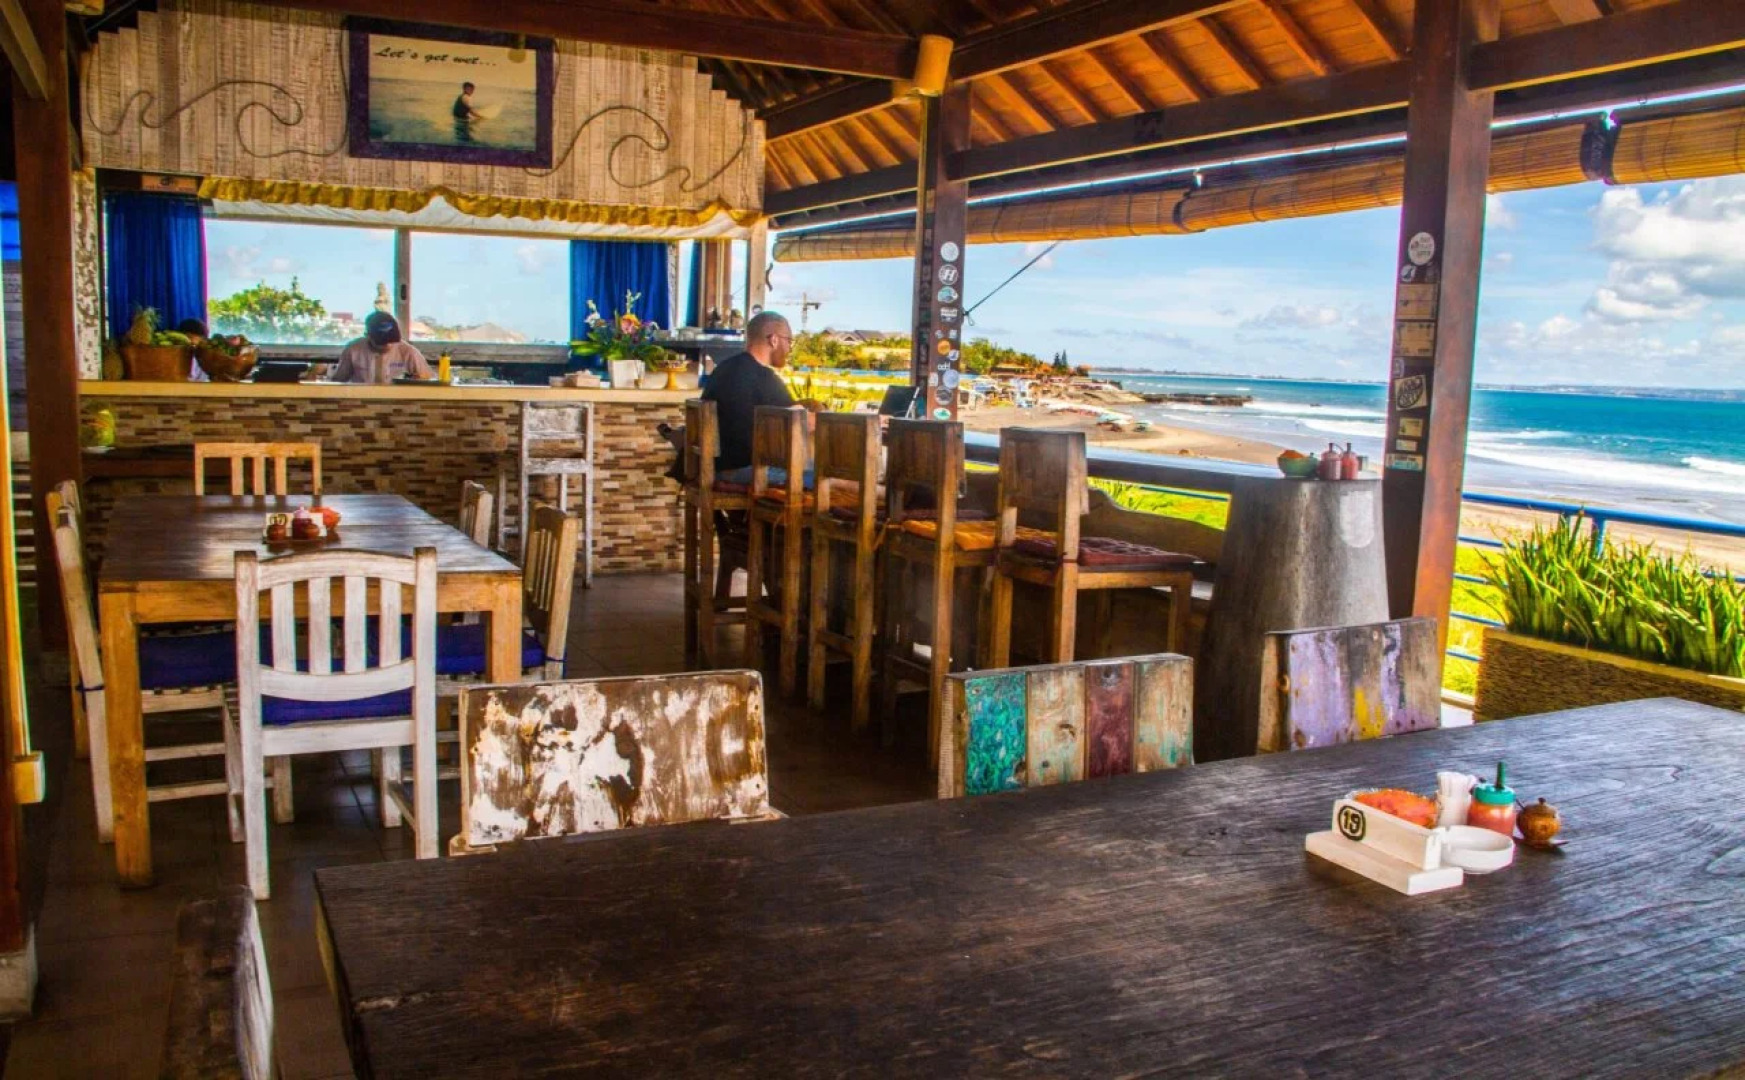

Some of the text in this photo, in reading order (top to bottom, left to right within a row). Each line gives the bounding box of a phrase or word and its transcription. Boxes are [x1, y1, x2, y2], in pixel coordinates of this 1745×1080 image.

[374, 47, 418, 60] Let's
[424, 54, 449, 63] get
[1343, 810, 1361, 834] 19
